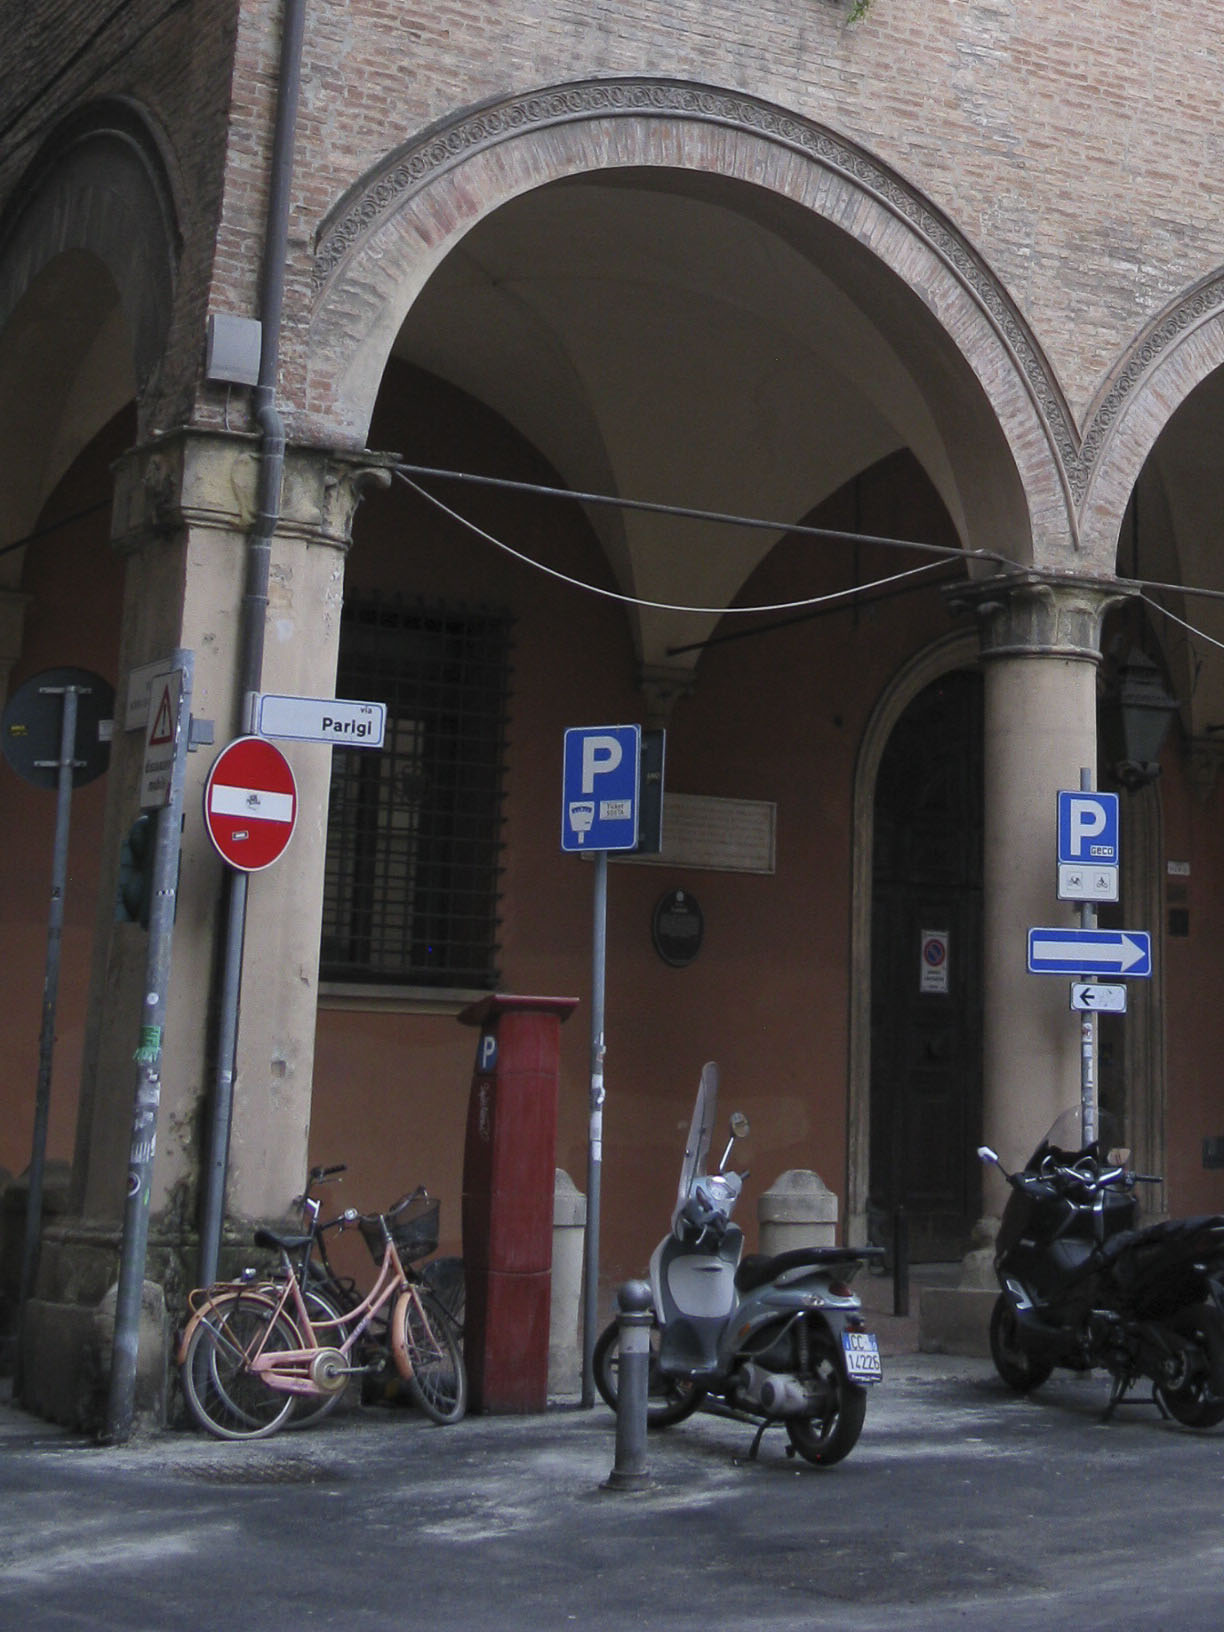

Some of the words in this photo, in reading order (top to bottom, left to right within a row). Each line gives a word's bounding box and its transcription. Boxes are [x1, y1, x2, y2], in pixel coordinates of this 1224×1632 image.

[360, 705, 373, 714] via
[322, 717, 372, 737] Parigi
[581, 736, 623, 794] P
[1070, 798, 1107, 856] P
[481, 1036, 496, 1069] P
